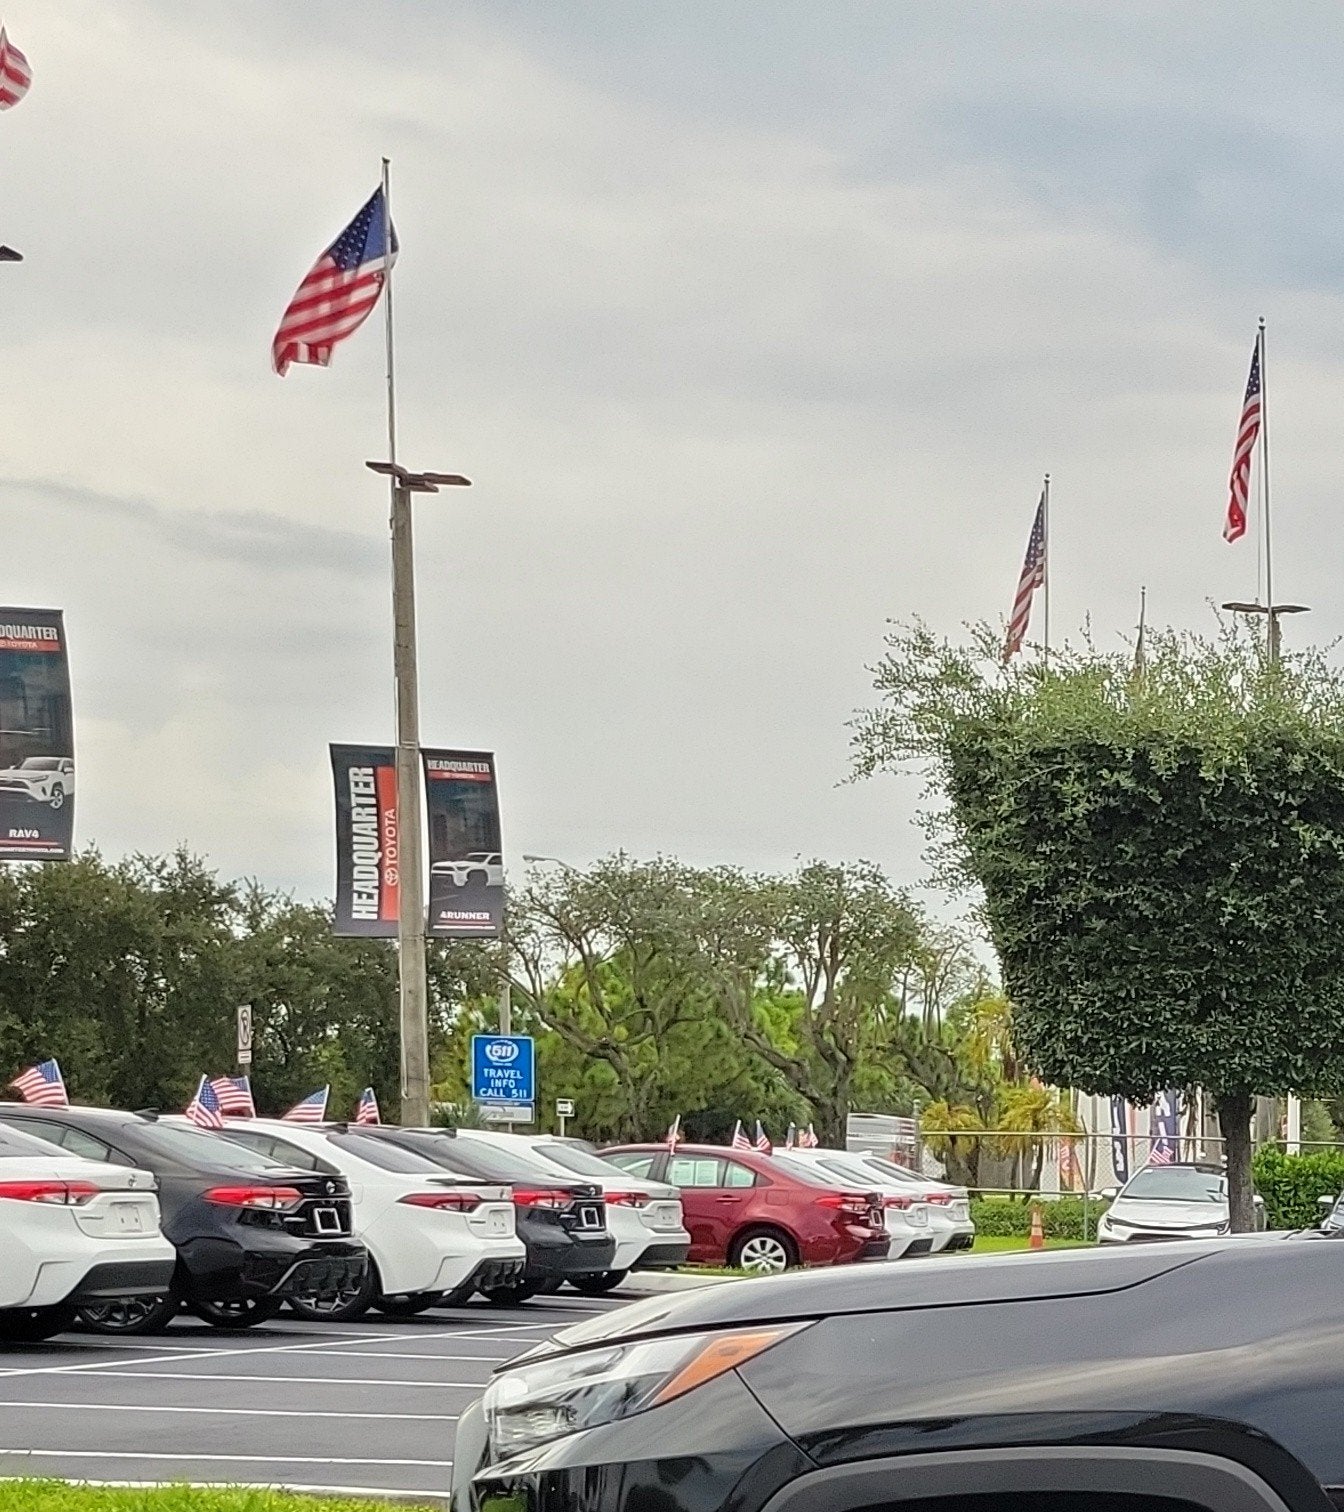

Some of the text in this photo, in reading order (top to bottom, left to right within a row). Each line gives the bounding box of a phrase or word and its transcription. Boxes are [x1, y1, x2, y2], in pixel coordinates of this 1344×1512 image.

[427, 759, 490, 773] HEADQUARTER
[9, 829, 40, 839] RAV4
[384, 808, 398, 867] TOYOTA
[349, 766, 382, 920] HEADQUARTER
[440, 910, 490, 920] 4RUNNER
[491, 1045, 513, 1057] 511
[483, 1068, 524, 1080] TRAVEL
[490, 1079, 516, 1089] INFO
[480, 1088, 527, 1098] CALL 511
